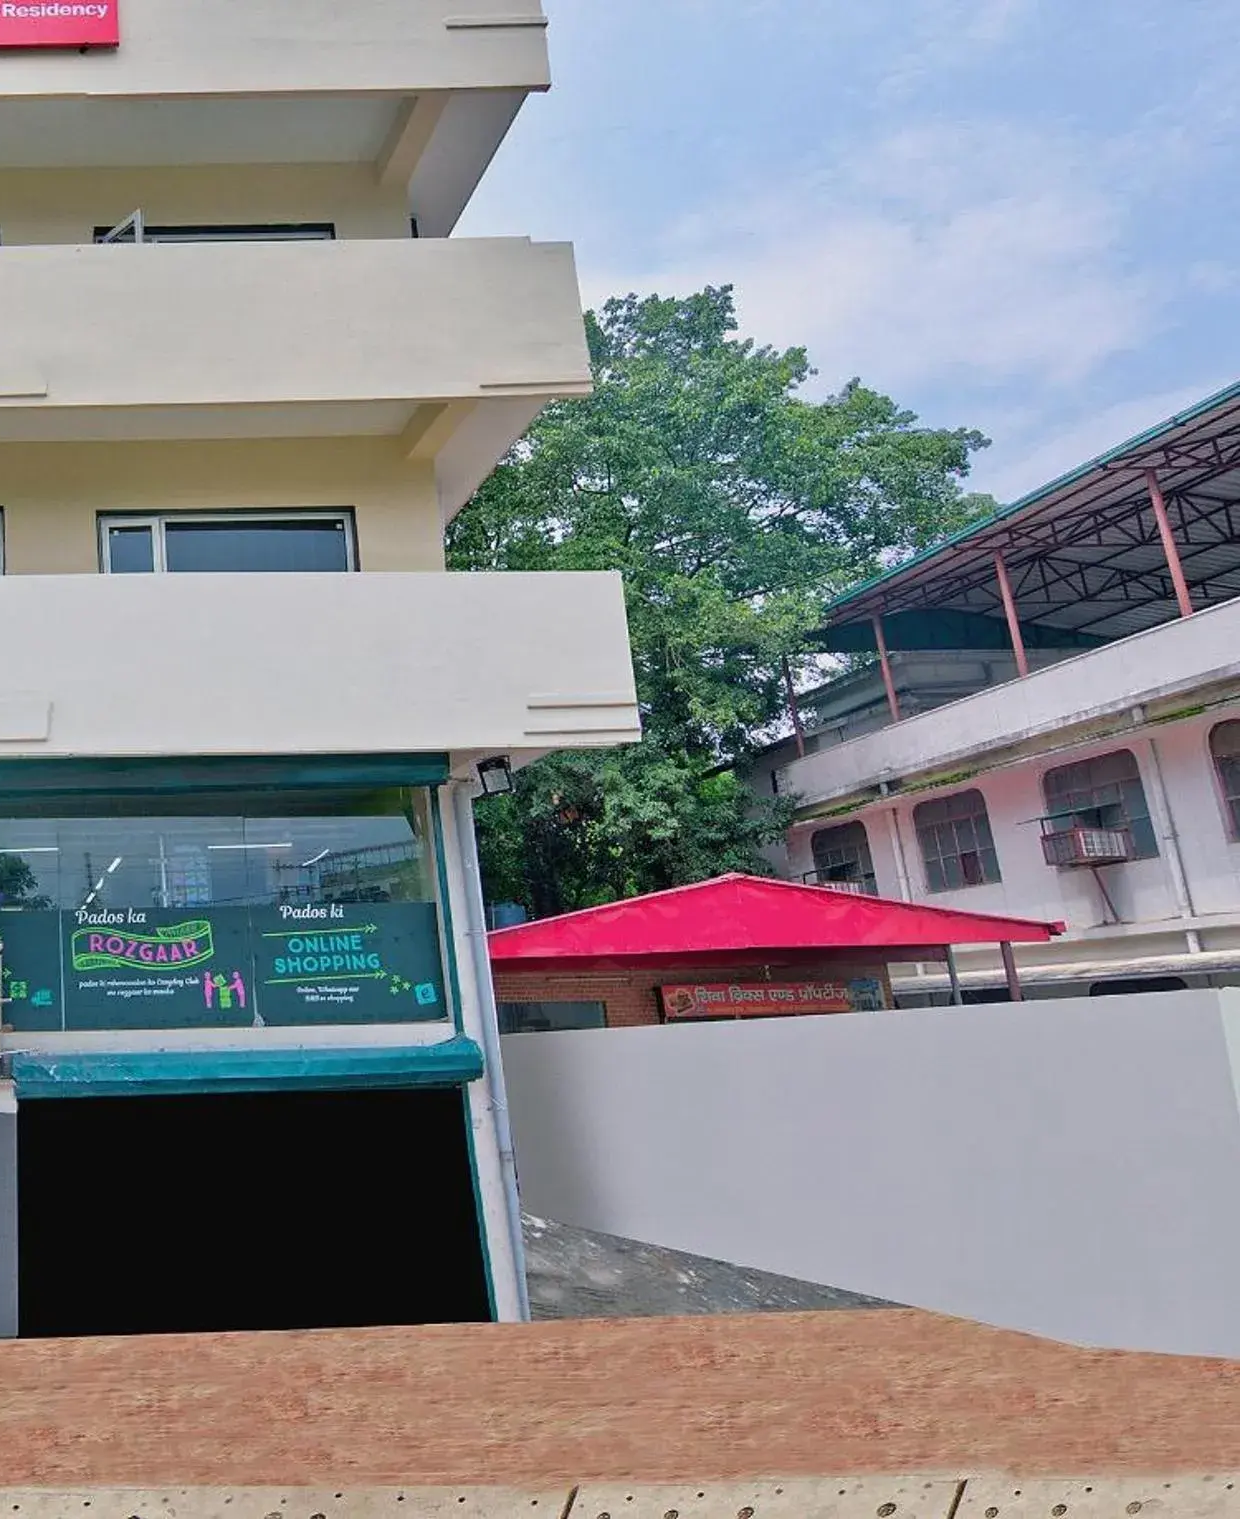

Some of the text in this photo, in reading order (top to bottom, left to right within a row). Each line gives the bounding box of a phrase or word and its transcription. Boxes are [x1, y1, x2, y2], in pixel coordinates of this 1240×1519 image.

[2, 4, 108, 19] Residency
[75, 908, 147, 924] Pados ka
[279, 904, 345, 919] Pados ki
[89, 934, 198, 962] ROZGAAR
[287, 935, 363, 953] ONLINE
[274, 953, 381, 973] SHOPPING
